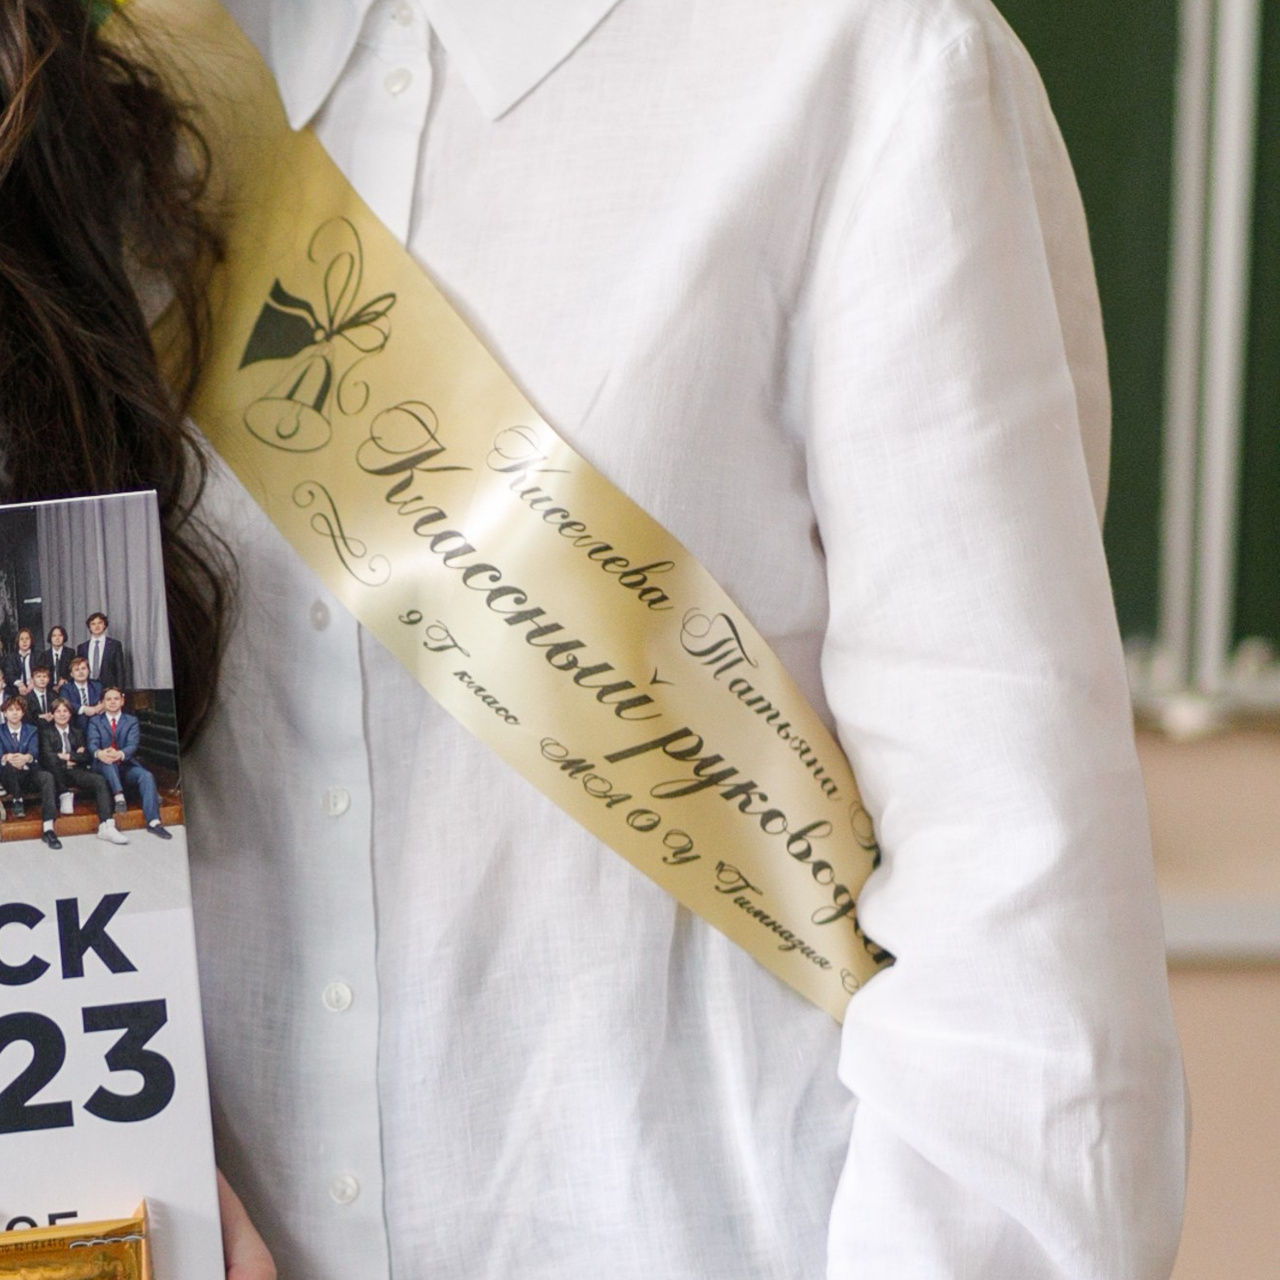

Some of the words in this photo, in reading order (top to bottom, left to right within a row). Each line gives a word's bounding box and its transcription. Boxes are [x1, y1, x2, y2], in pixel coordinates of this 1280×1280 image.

[356, 400, 676, 721] Классный
[603, 726, 897, 965] руковод
[398, 609, 423, 625] 9
[453, 669, 520, 726] класс
[486, 425, 675, 611] Киселева
[680, 607, 842, 801] Татьяна
